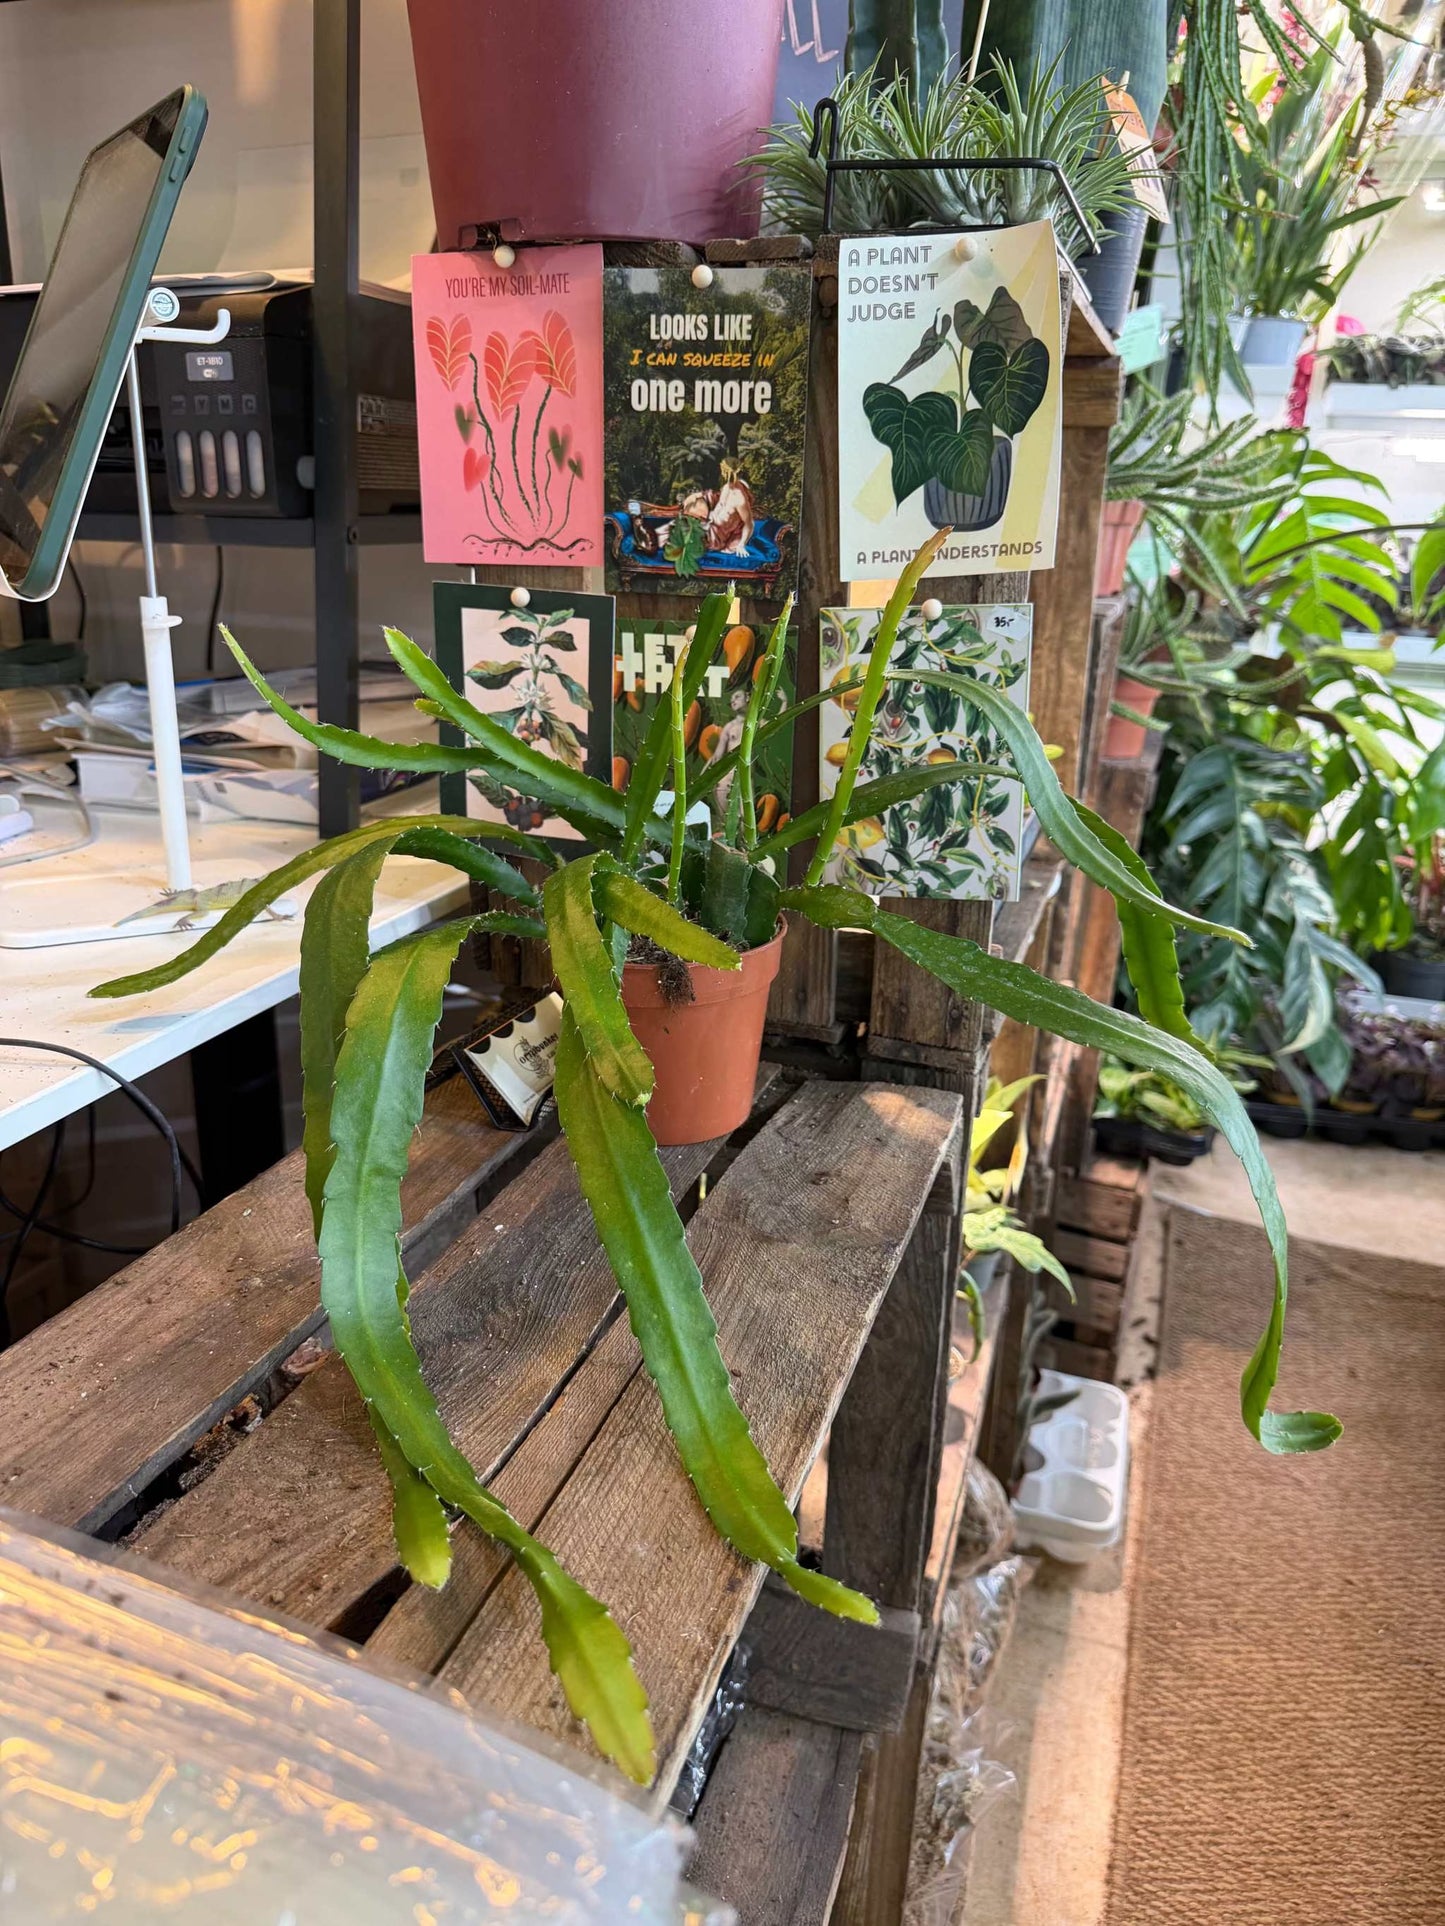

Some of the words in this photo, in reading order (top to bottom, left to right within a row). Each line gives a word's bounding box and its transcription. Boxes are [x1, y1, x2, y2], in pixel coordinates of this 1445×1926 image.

[847, 248, 860, 267] A
[866, 245, 932, 266] PLANT
[445, 276, 486, 299] YOU'RE
[489, 276, 507, 297] MY
[509, 272, 570, 296] SOIL-MATE
[847, 272, 939, 295] DOESN'T
[847, 301, 916, 323] JUDGE
[650, 313, 709, 341] LOOKS
[714, 313, 752, 341] LIKE
[629, 349, 643, 366] I
[646, 352, 678, 366] CAN
[683, 352, 751, 367] SQUEEZE
[758, 353, 776, 368] IN
[631, 378, 686, 412] one
[694, 379, 772, 414] more
[857, 551, 867, 565] A
[925, 541, 1043, 563] NDERSTANDS
